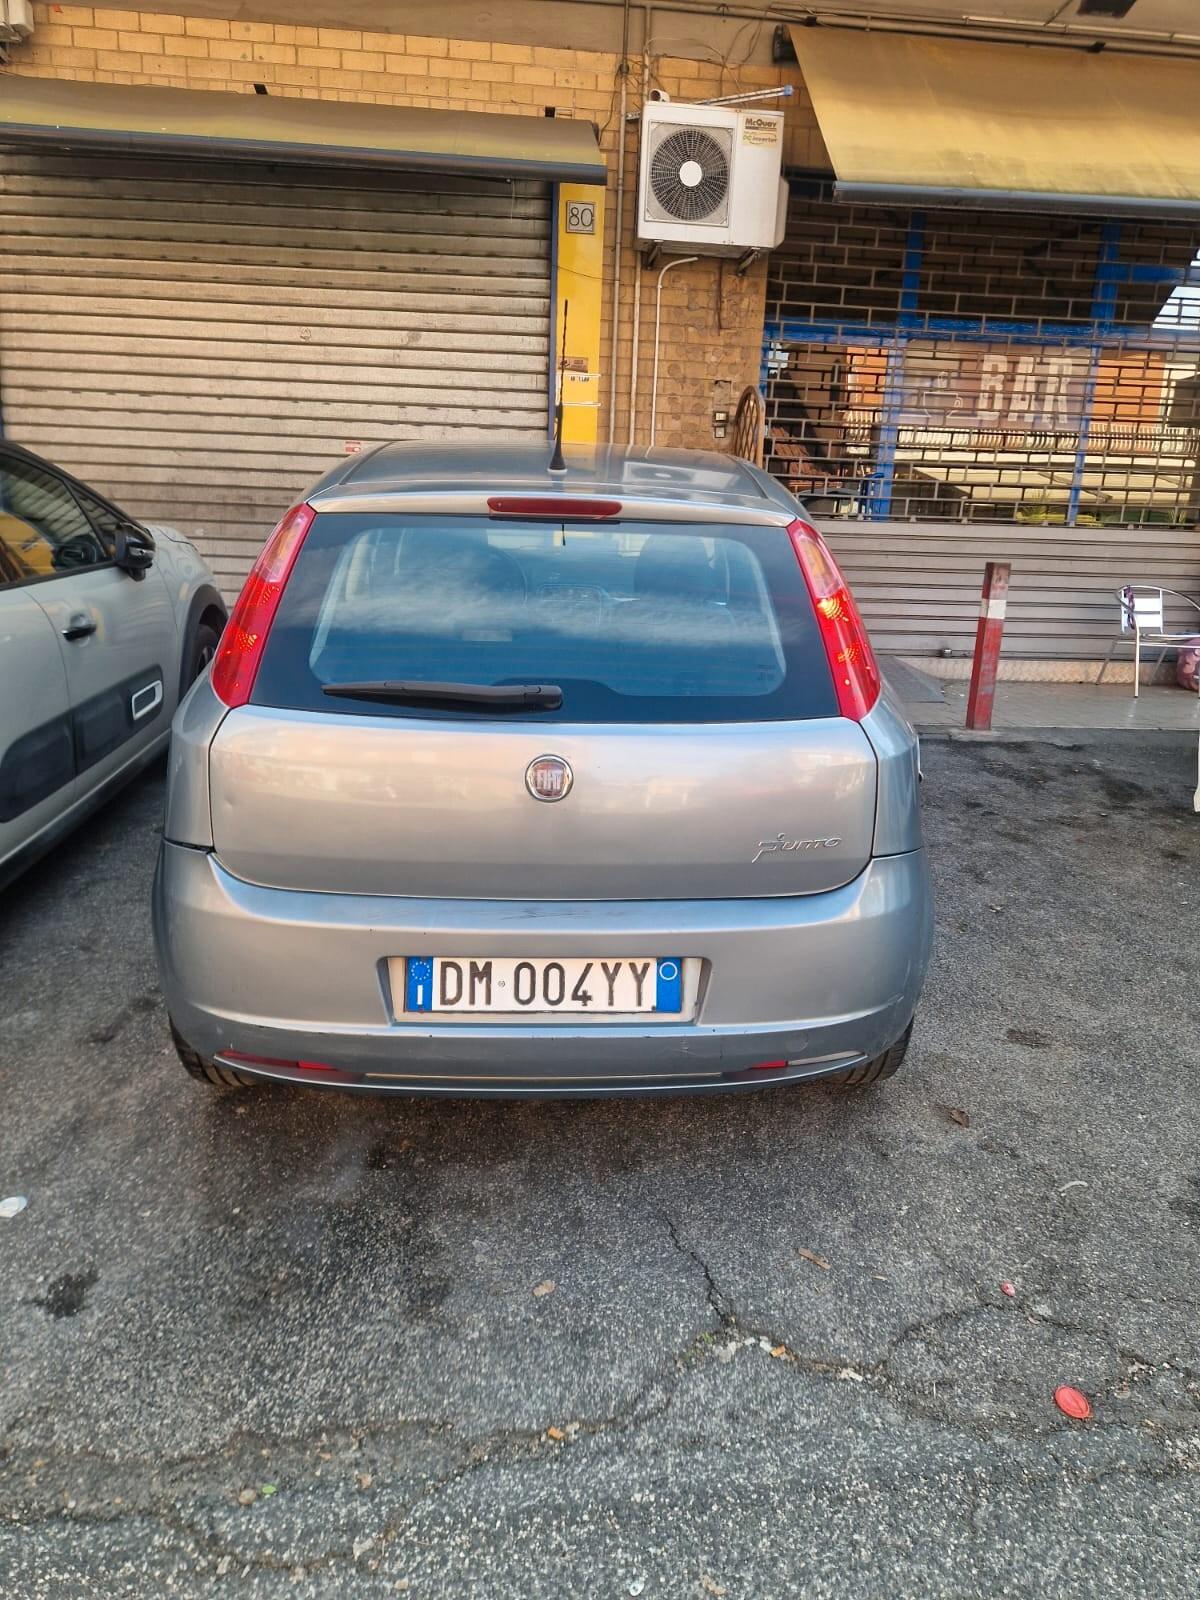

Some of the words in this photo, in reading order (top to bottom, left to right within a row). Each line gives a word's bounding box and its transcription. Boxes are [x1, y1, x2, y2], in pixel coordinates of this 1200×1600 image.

[745, 117, 777, 128] McQuay
[569, 206, 593, 227] 80
[977, 354, 1073, 425] BAR
[535, 769, 564, 791] FIAT
[440, 961, 493, 1006] DM
[514, 961, 651, 1007] 004YY
